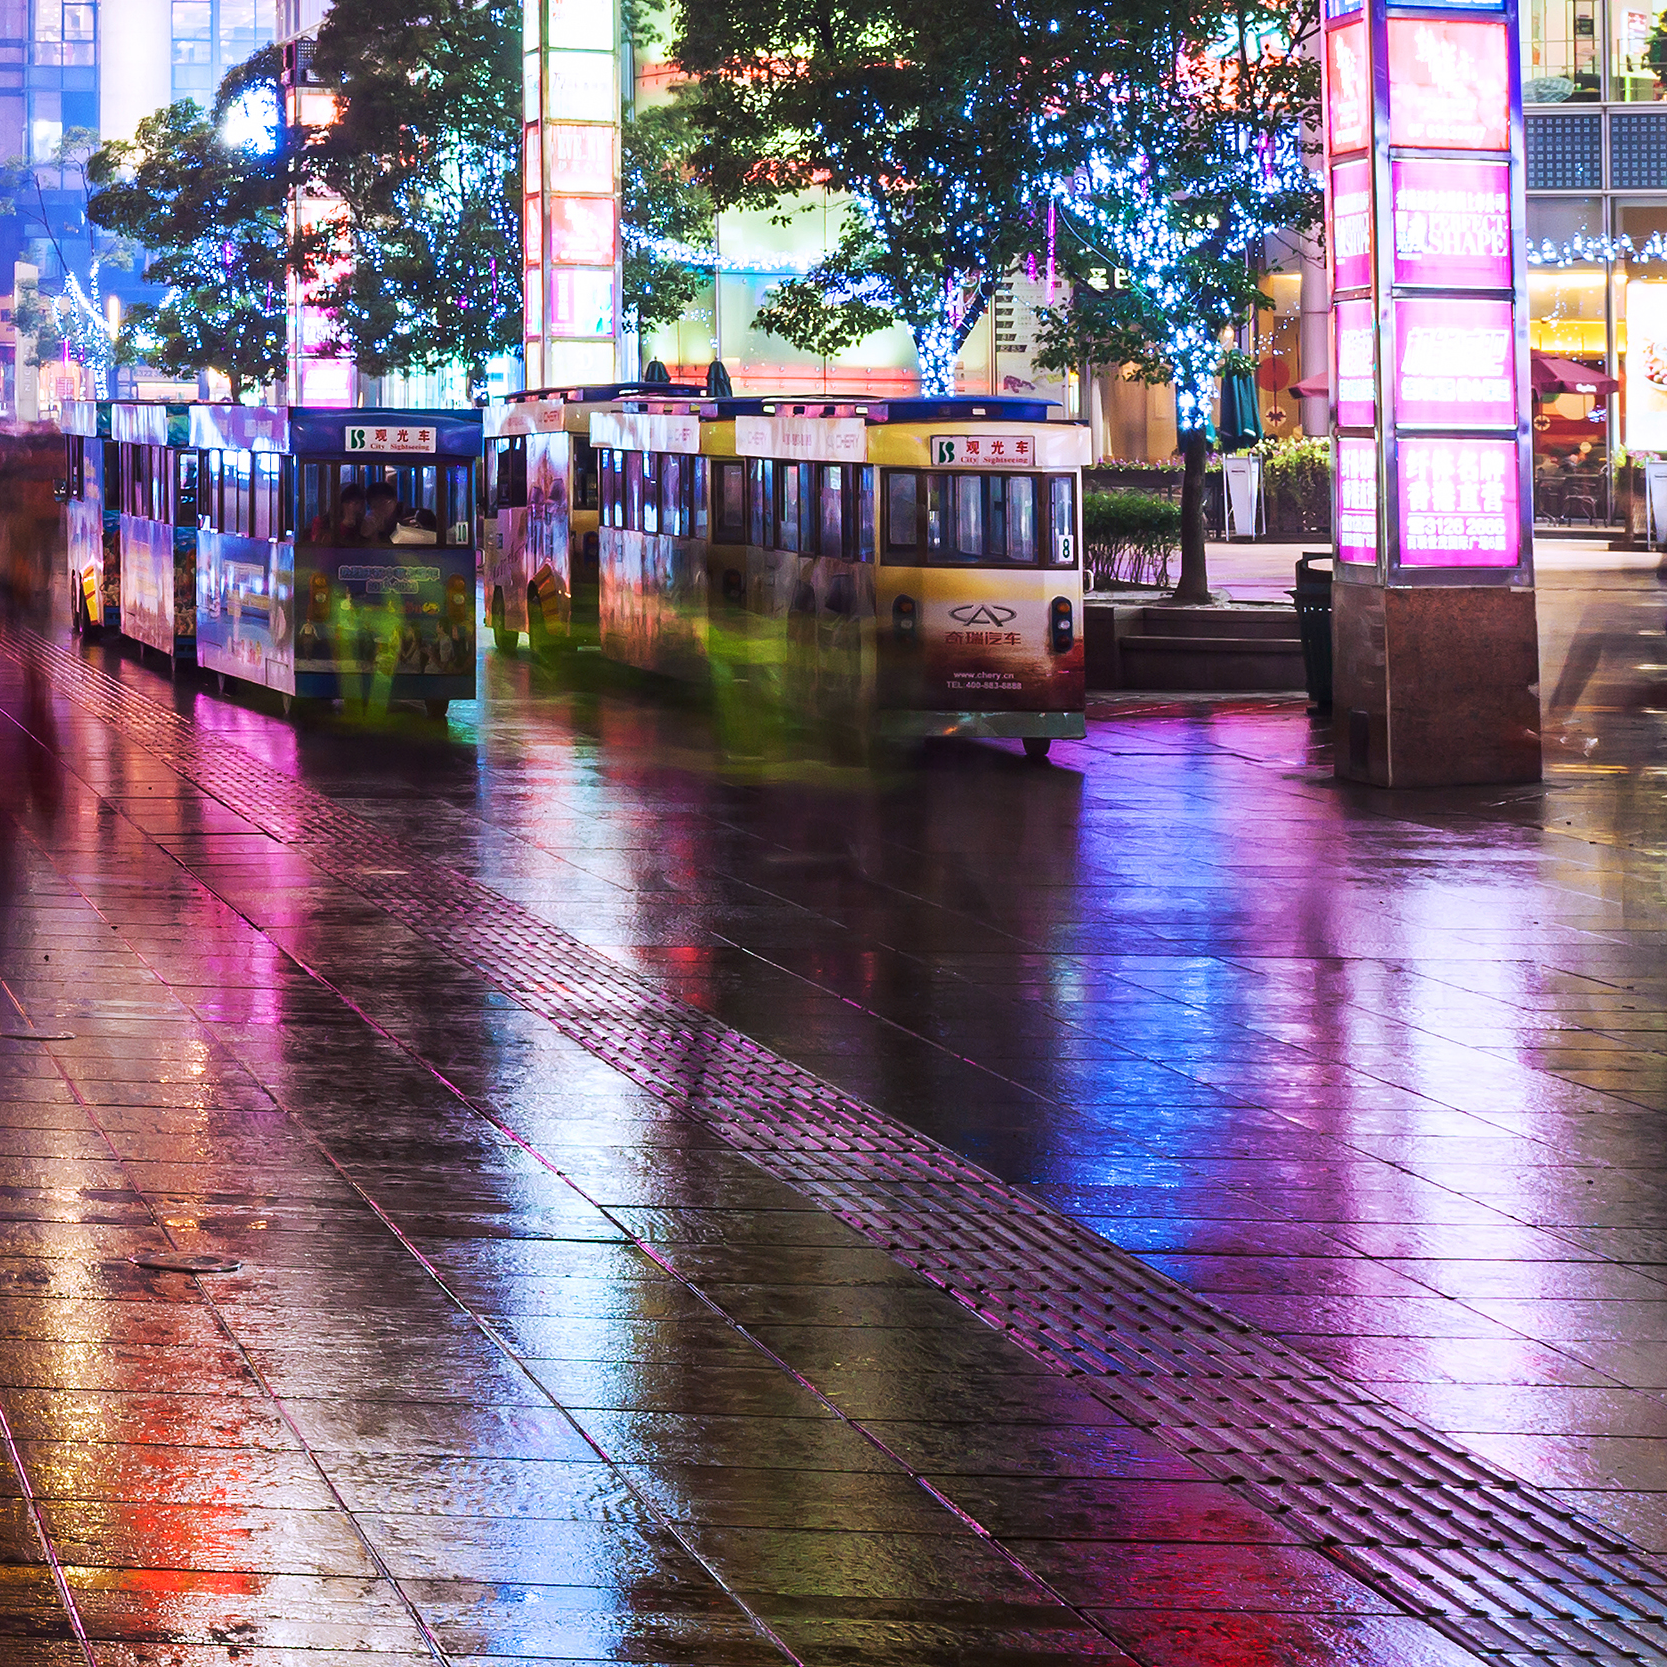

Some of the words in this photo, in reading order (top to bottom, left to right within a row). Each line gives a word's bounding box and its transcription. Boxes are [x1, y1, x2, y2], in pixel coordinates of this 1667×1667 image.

[1429, 213, 1507, 232] PERFECT
[1428, 233, 1508, 257] SHAPE
[375, 429, 430, 442] 观光车
[966, 441, 1029, 455] 观光车
[960, 456, 977, 465] City
[983, 456, 1029, 465] Sightseeing
[1063, 539, 1070, 558] 8
[945, 630, 1022, 645] 奇瑞汽车
[953, 671, 1015, 680] www.chery.cn
